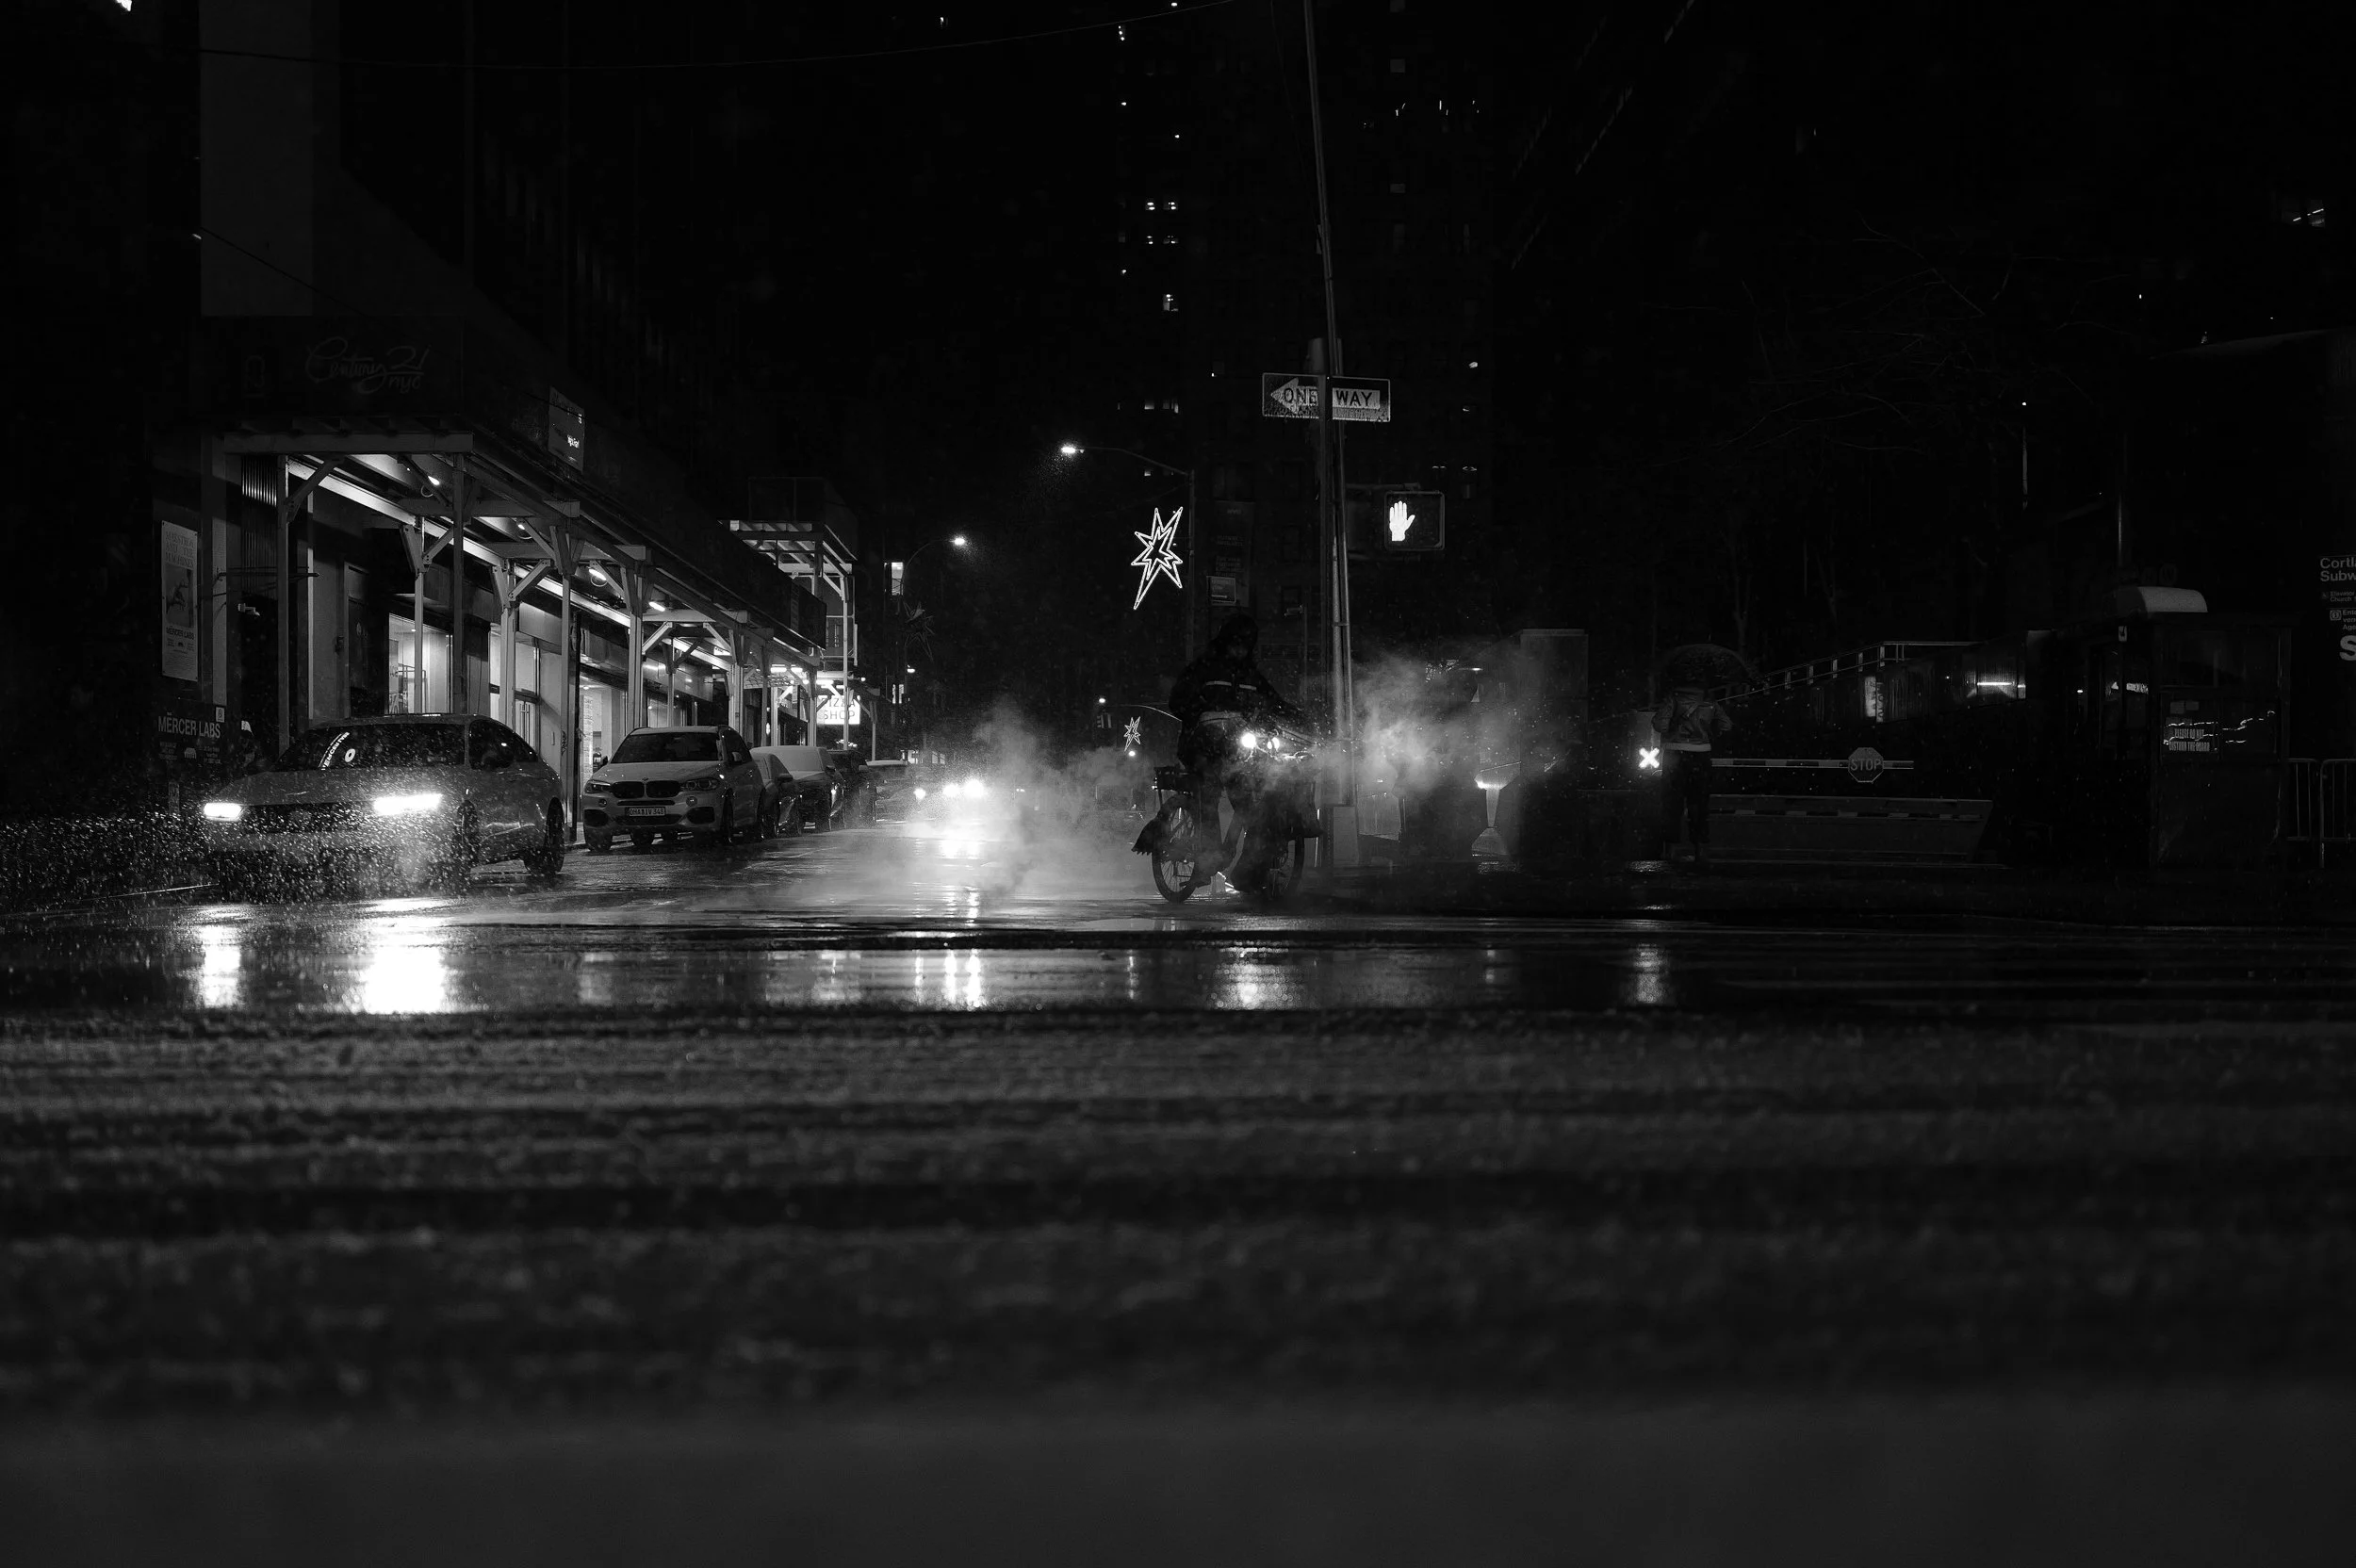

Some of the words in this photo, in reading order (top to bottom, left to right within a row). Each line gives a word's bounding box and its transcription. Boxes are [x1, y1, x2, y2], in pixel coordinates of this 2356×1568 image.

[305, 335, 387, 395] Century
[386, 344, 432, 371] 21
[388, 374, 423, 395] nyc
[1284, 386, 1318, 405] ONE
[1335, 389, 1372, 406] WAY
[2320, 557, 2356, 569] Cortl
[199, 721, 221, 739] LABS
[1850, 758, 1882, 772] STOP
